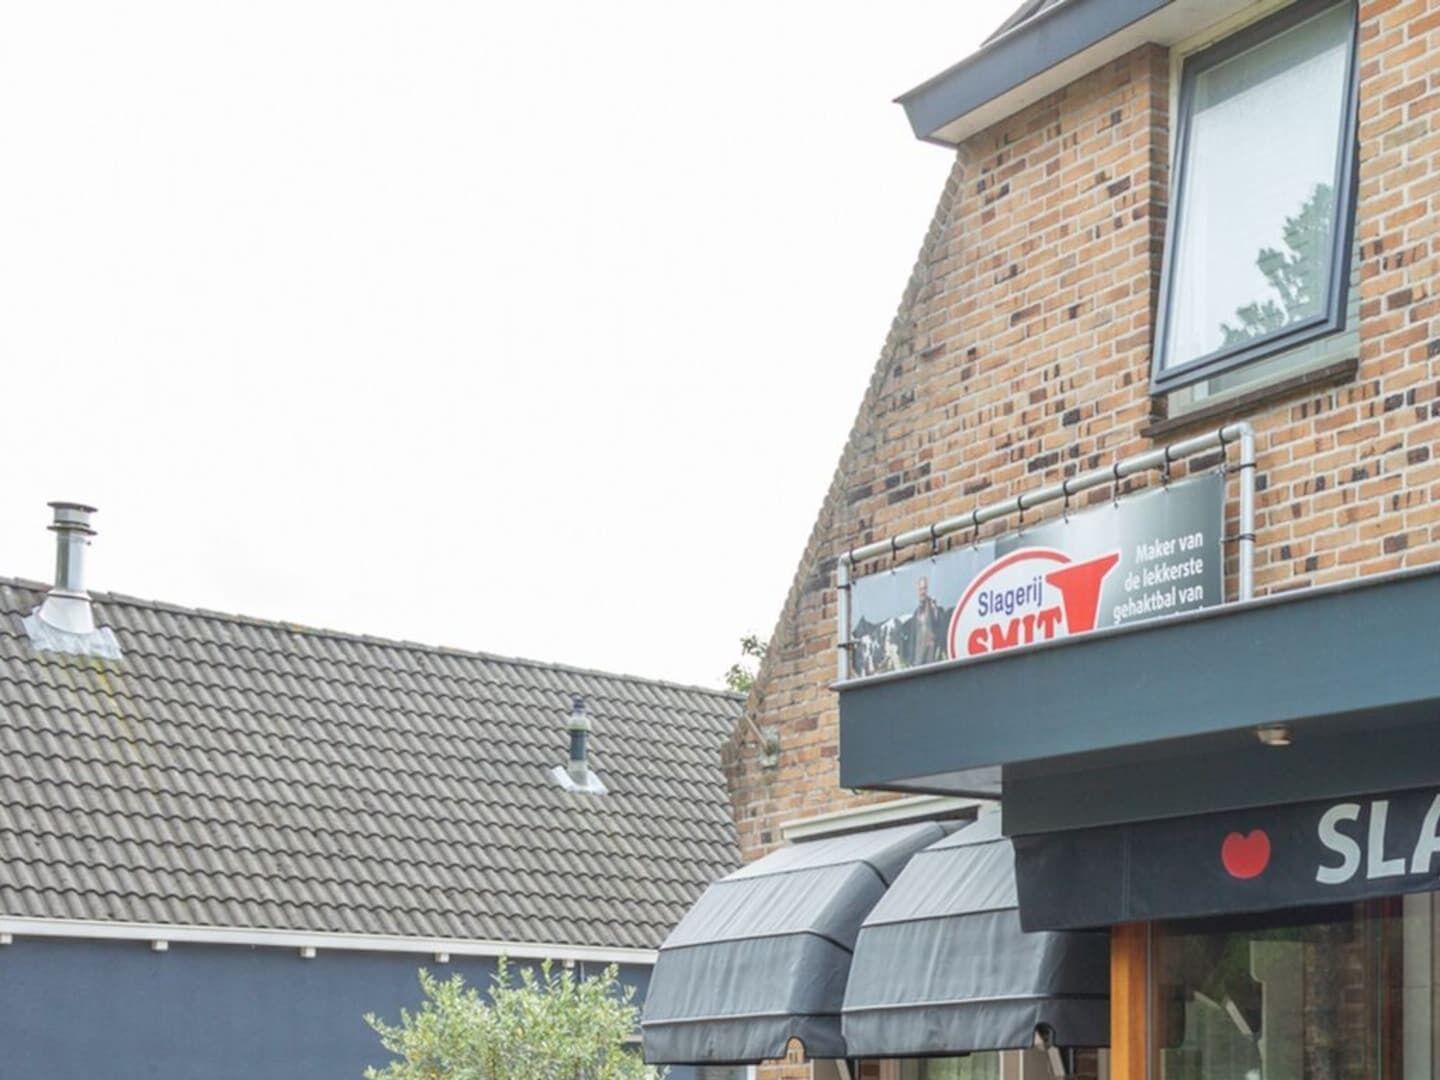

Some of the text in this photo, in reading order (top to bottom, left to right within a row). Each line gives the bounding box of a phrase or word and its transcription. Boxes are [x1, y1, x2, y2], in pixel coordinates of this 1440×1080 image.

[1136, 532, 1203, 563] Maker van
[1124, 557, 1203, 592] de lekkerste
[978, 576, 1042, 617] Slagerij
[1113, 585, 1203, 625] gehaktbal van
[967, 605, 1062, 655] SMIT
